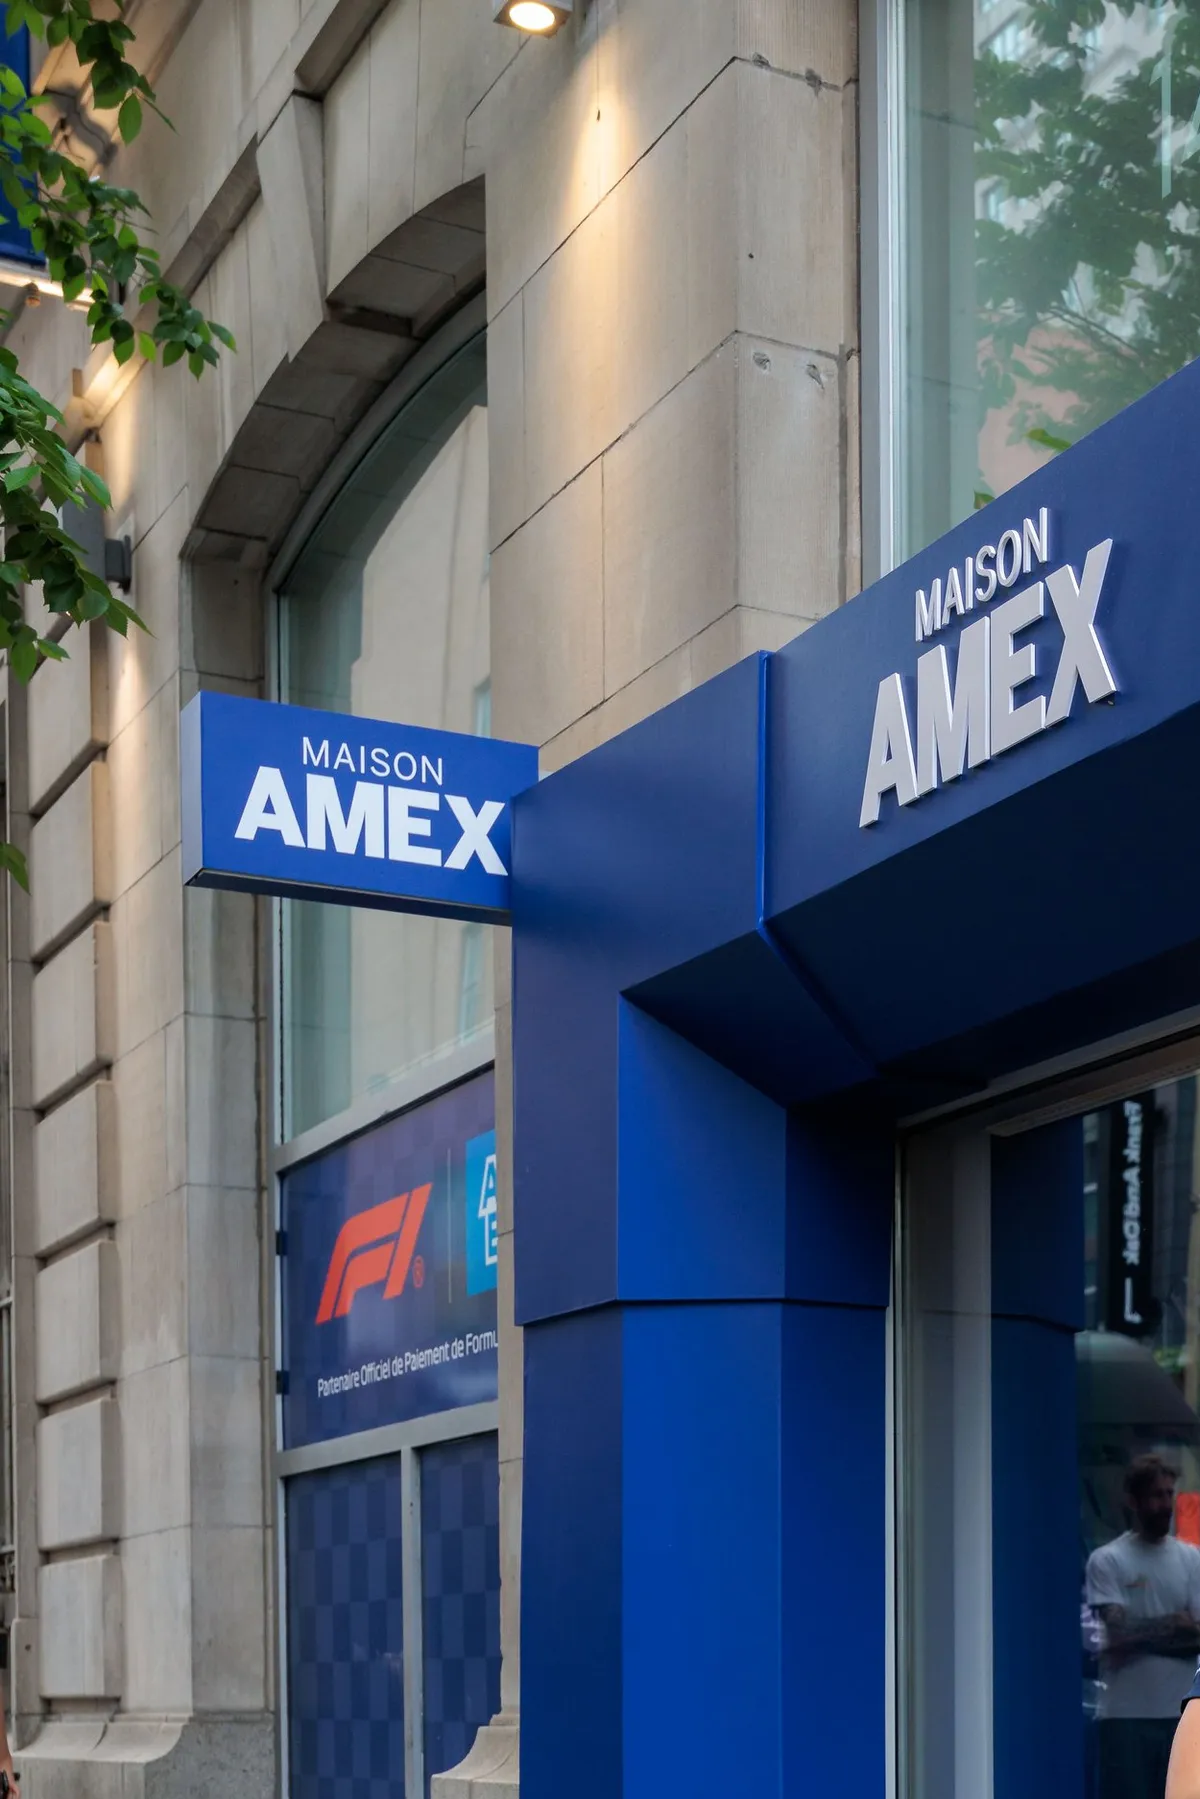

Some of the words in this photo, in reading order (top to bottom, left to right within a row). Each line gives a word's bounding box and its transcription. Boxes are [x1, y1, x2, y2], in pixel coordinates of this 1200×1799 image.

[915, 507, 1048, 642] MAISON
[859, 538, 1118, 828] AMEX
[301, 736, 443, 786] MAISON
[234, 765, 509, 876] AMEX
[317, 1368, 360, 1398] Partenaire
[360, 1356, 391, 1386] Officiel
[391, 1355, 404, 1376] de
[404, 1341, 450, 1374] Paiement
[450, 1337, 465, 1360] de
[465, 1329, 499, 1357] Formu
